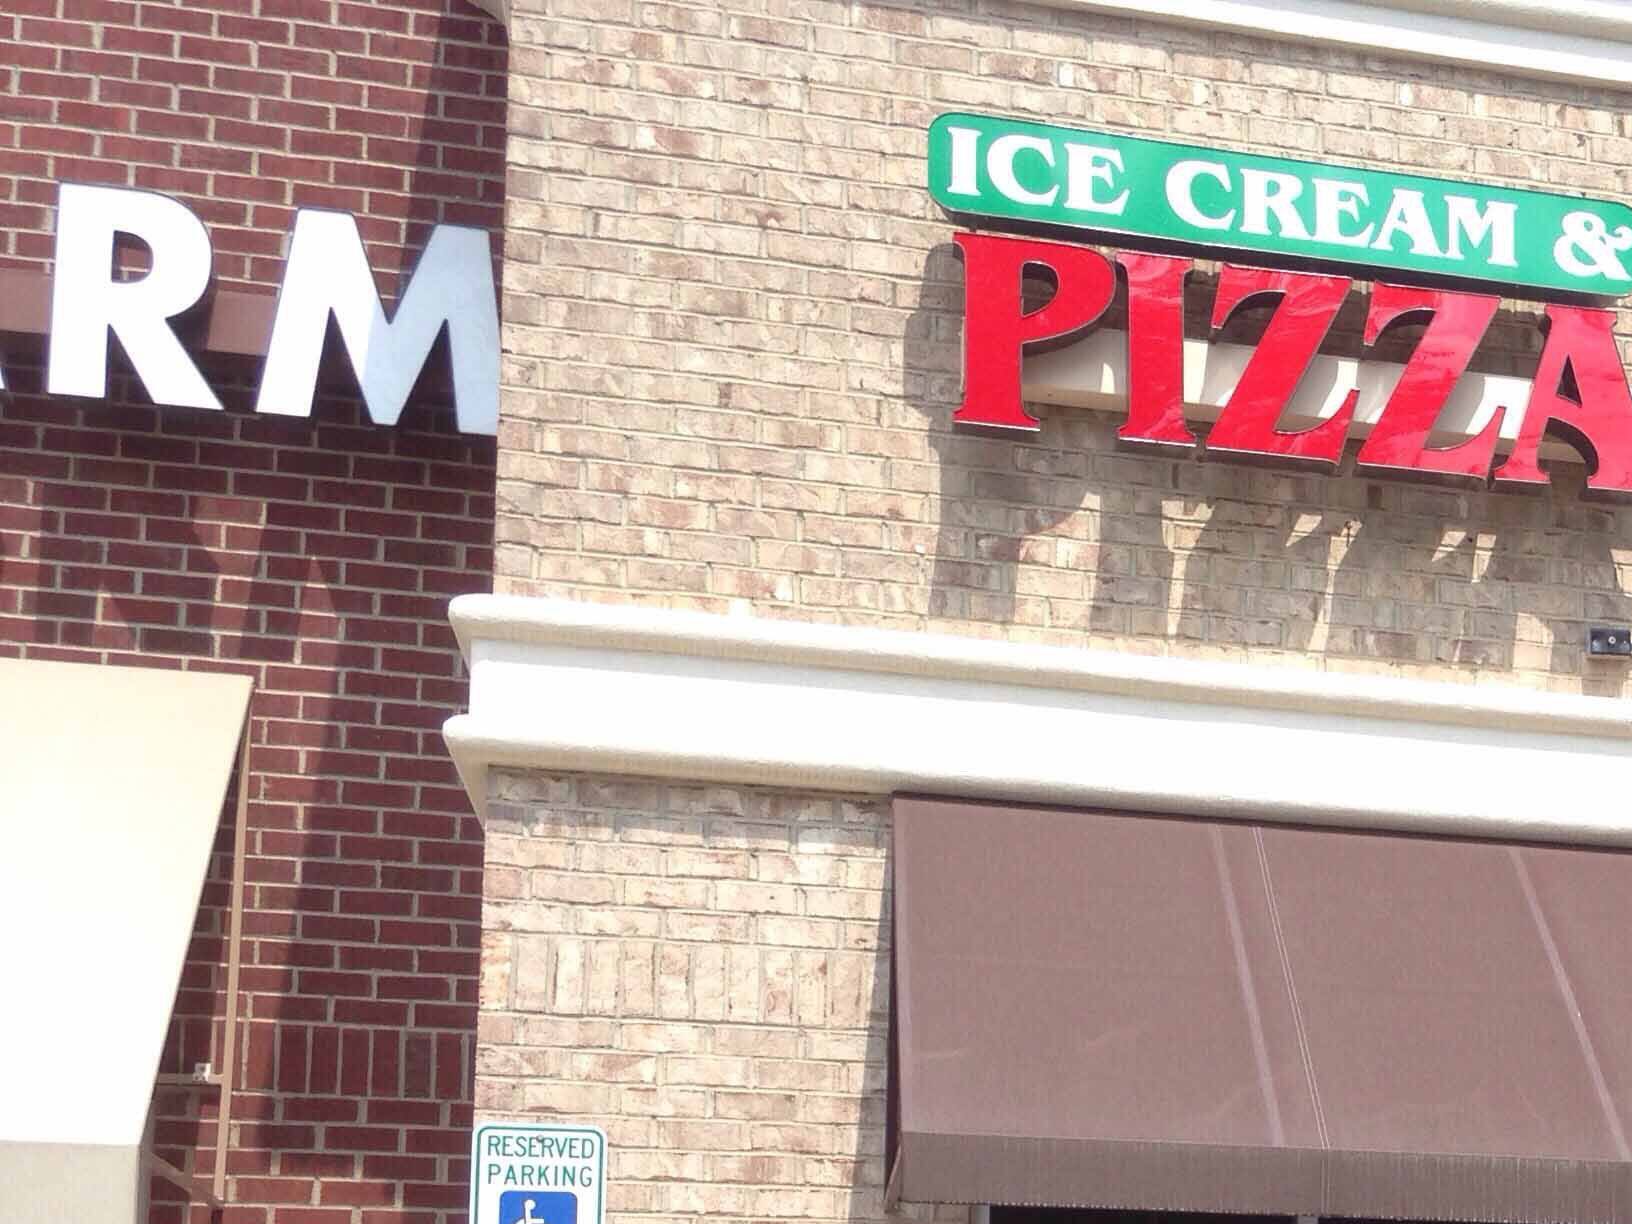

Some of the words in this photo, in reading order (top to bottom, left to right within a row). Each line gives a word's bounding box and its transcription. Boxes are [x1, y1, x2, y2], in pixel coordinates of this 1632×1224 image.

[948, 126, 1130, 216] ICE
[1165, 160, 1519, 268] CREAM
[0, 182, 503, 435] RM
[487, 1134, 595, 1160] RESERVED
[487, 1164, 593, 1188] PARKING
